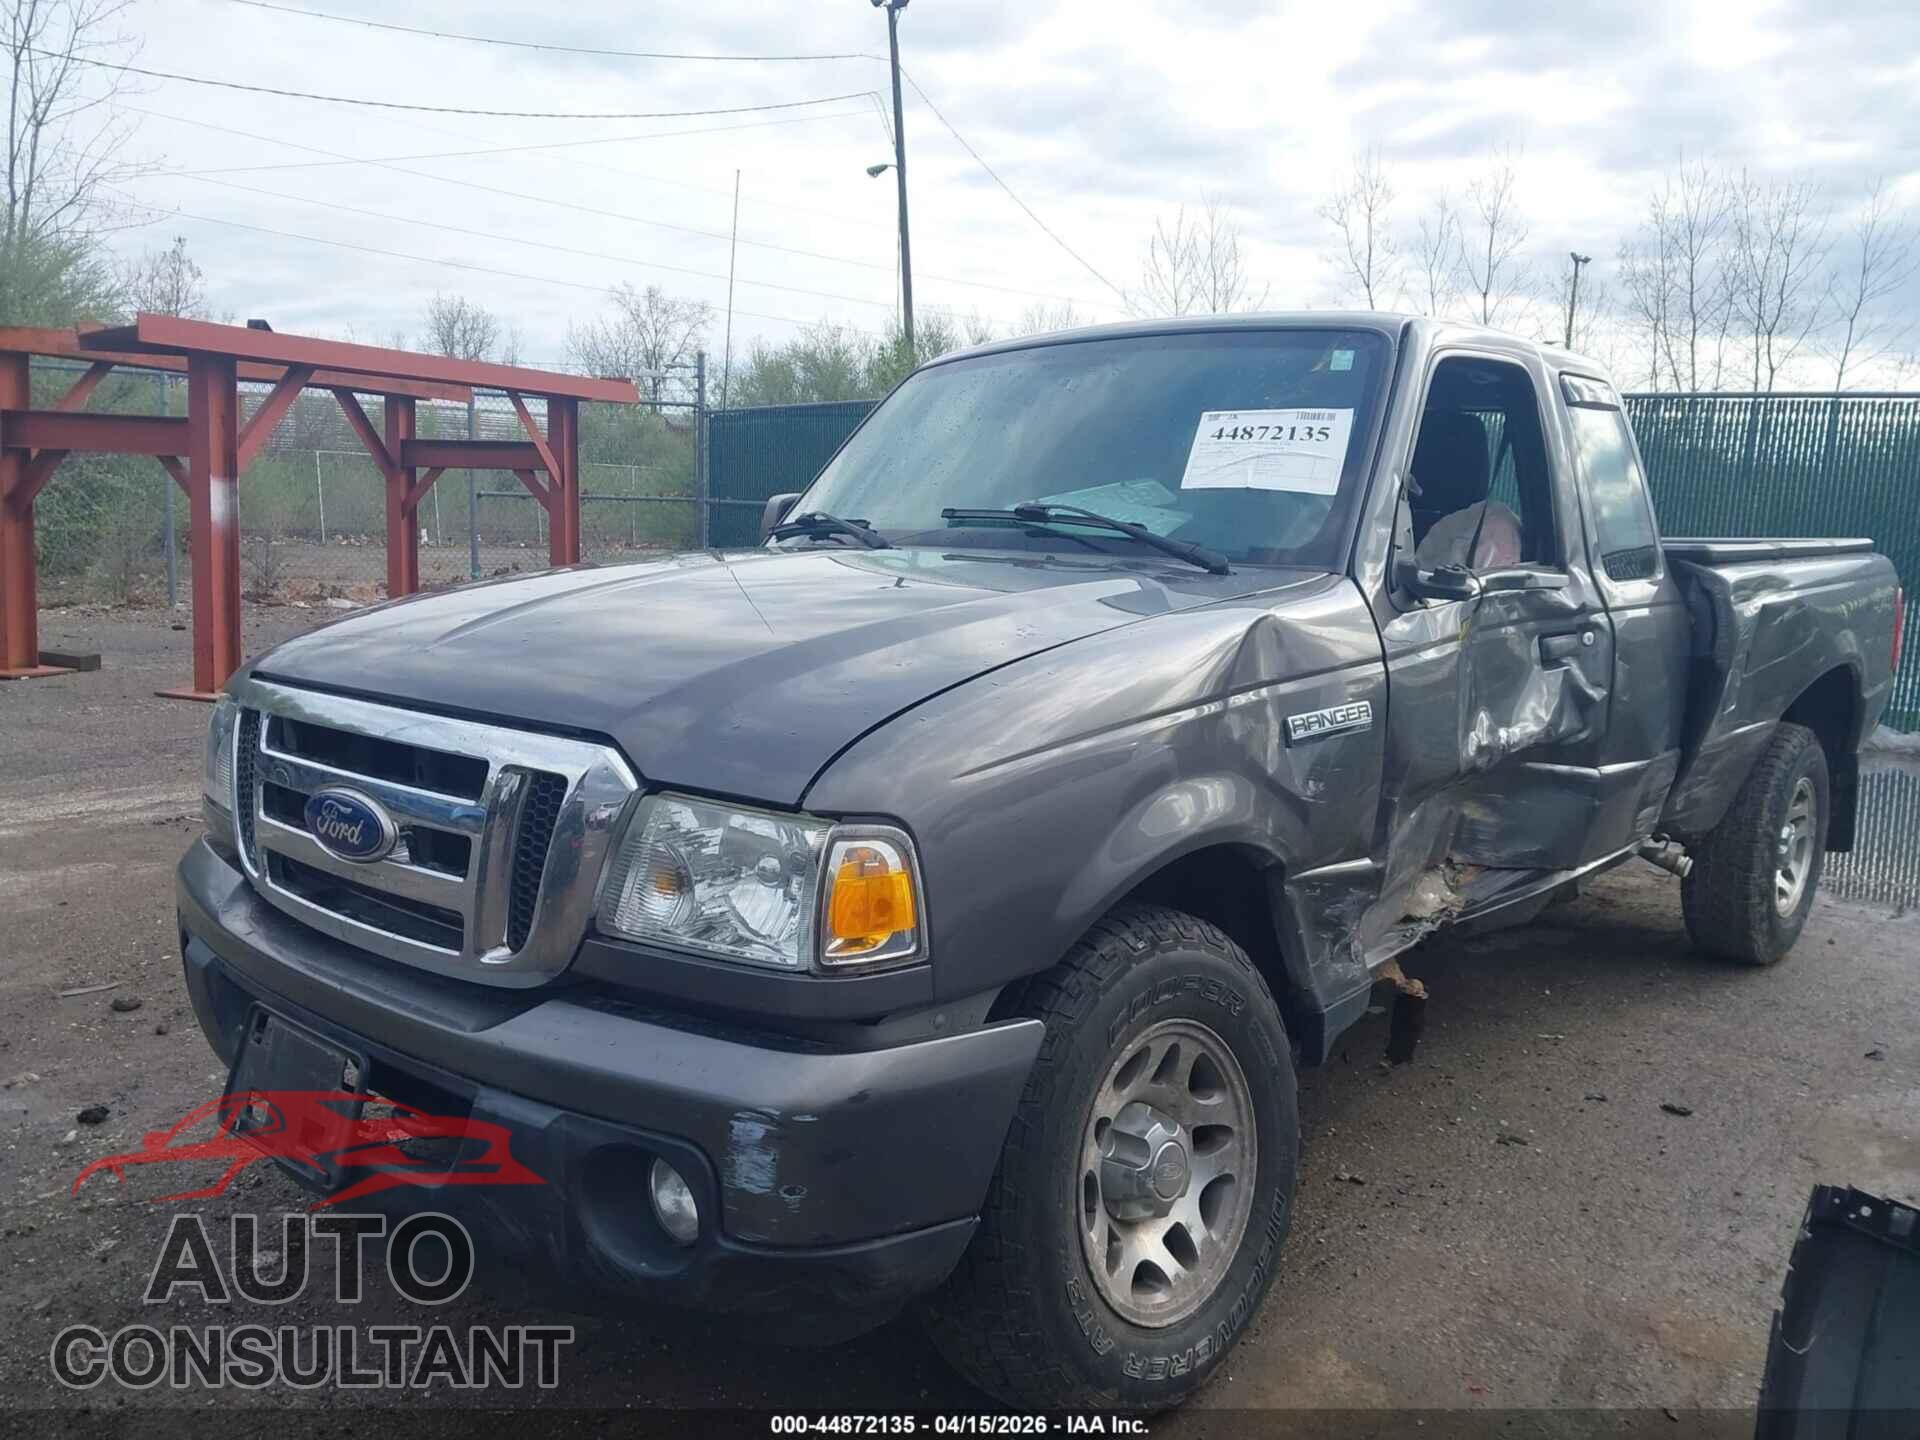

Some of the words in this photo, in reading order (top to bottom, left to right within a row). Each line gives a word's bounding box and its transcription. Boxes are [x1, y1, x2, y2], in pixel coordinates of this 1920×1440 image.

[1209, 425, 1331, 442] 44872135
[1290, 704, 1370, 735] RANGER
[317, 799, 364, 844] Ford
[1108, 974, 1246, 1049] COOPER
